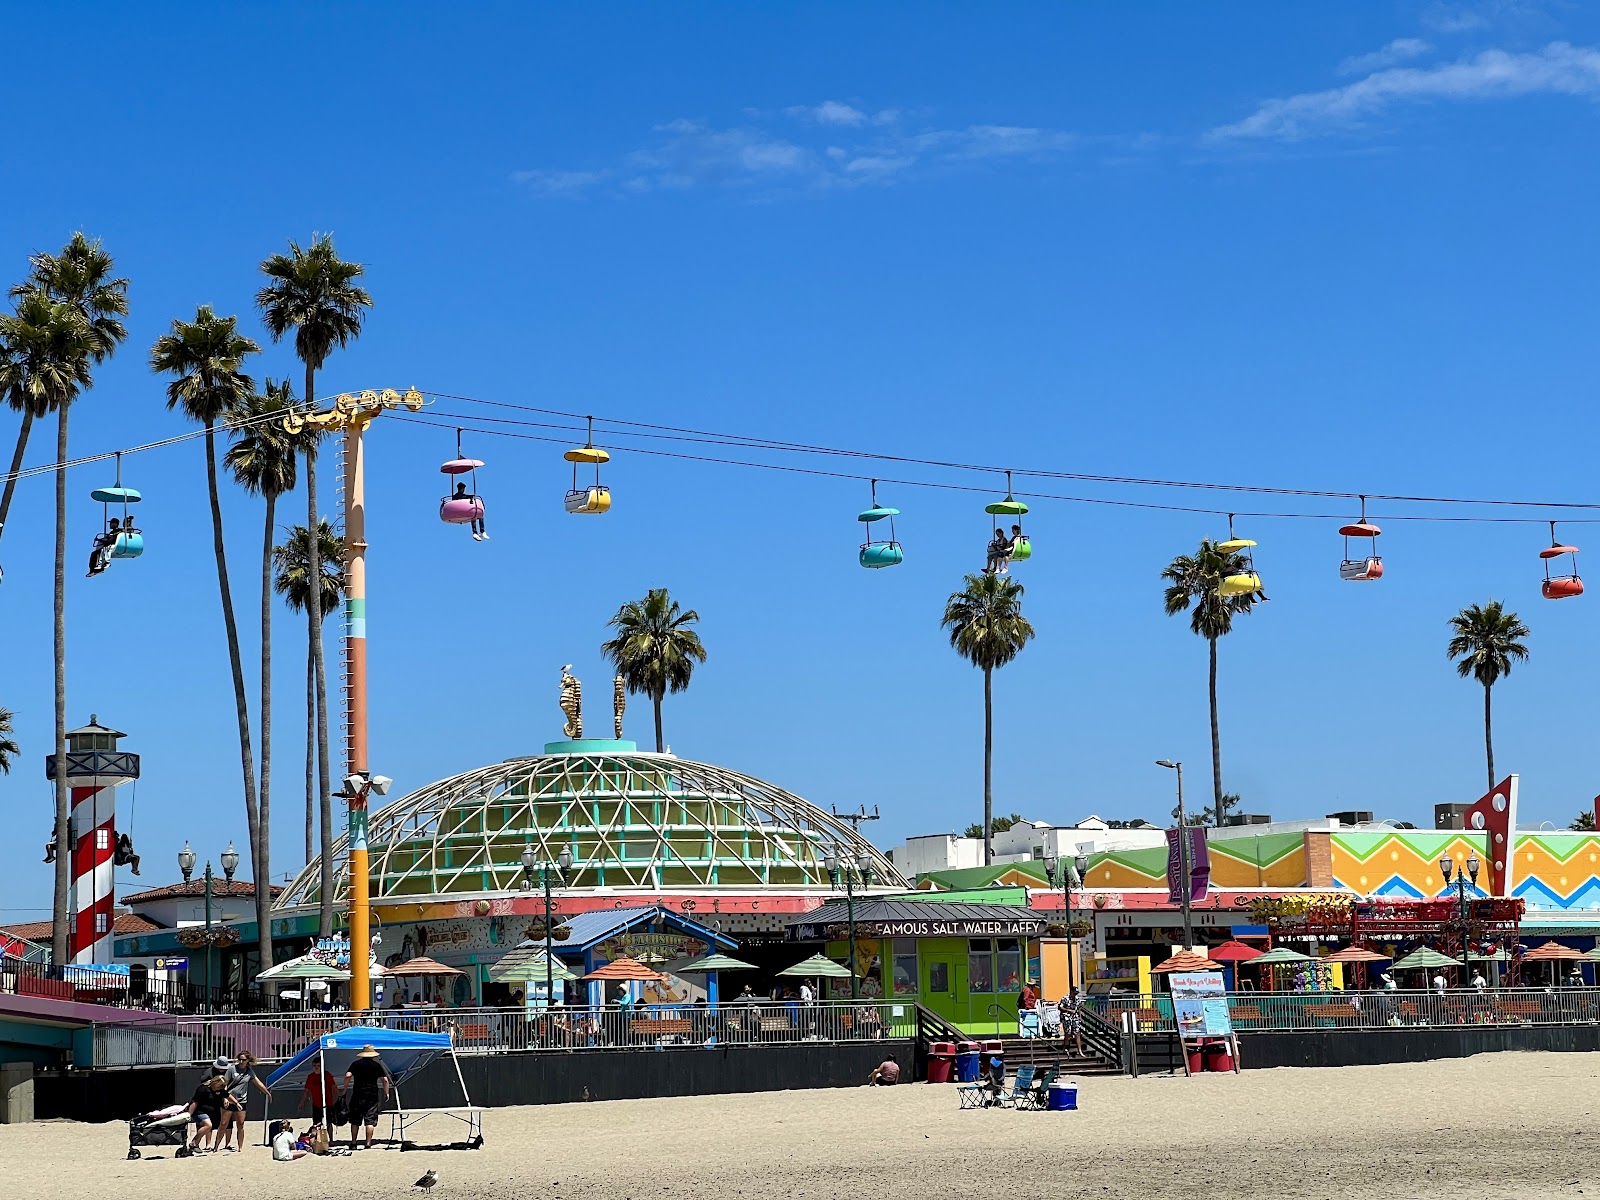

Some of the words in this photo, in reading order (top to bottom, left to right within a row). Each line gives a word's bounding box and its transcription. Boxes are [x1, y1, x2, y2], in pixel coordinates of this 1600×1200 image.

[1170, 829, 1181, 900] Boardwalk
[875, 922, 928, 935] FAMOUS
[932, 922, 959, 935] SALT
[963, 921, 1002, 934] WATER
[1005, 921, 1040, 933] TAFFY
[317, 937, 351, 953] dippi
